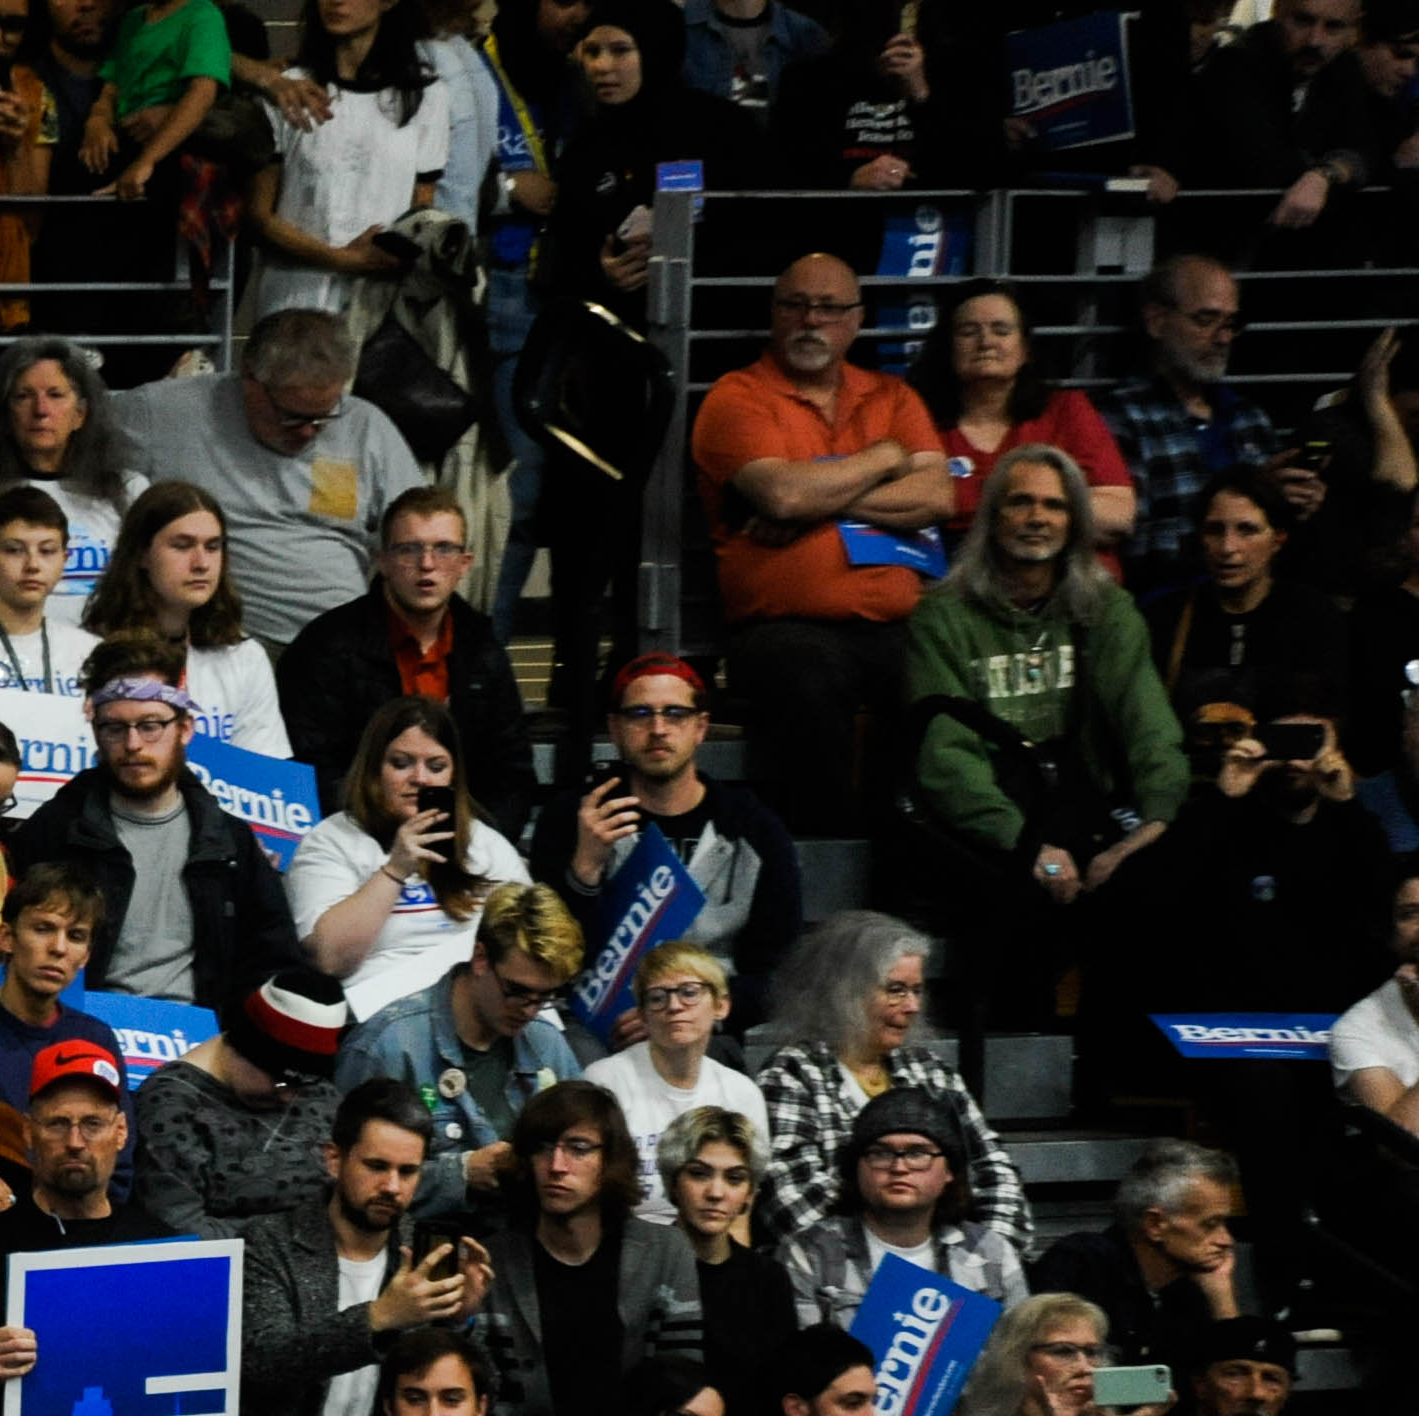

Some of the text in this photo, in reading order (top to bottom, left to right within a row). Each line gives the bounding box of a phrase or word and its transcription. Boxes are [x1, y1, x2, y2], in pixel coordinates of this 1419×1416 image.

[1009, 48, 1117, 114] Bernie
[193, 705, 232, 738] nie
[20, 734, 98, 776] rnie
[574, 863, 676, 1010] Bernie
[110, 1028, 203, 1060] erni
